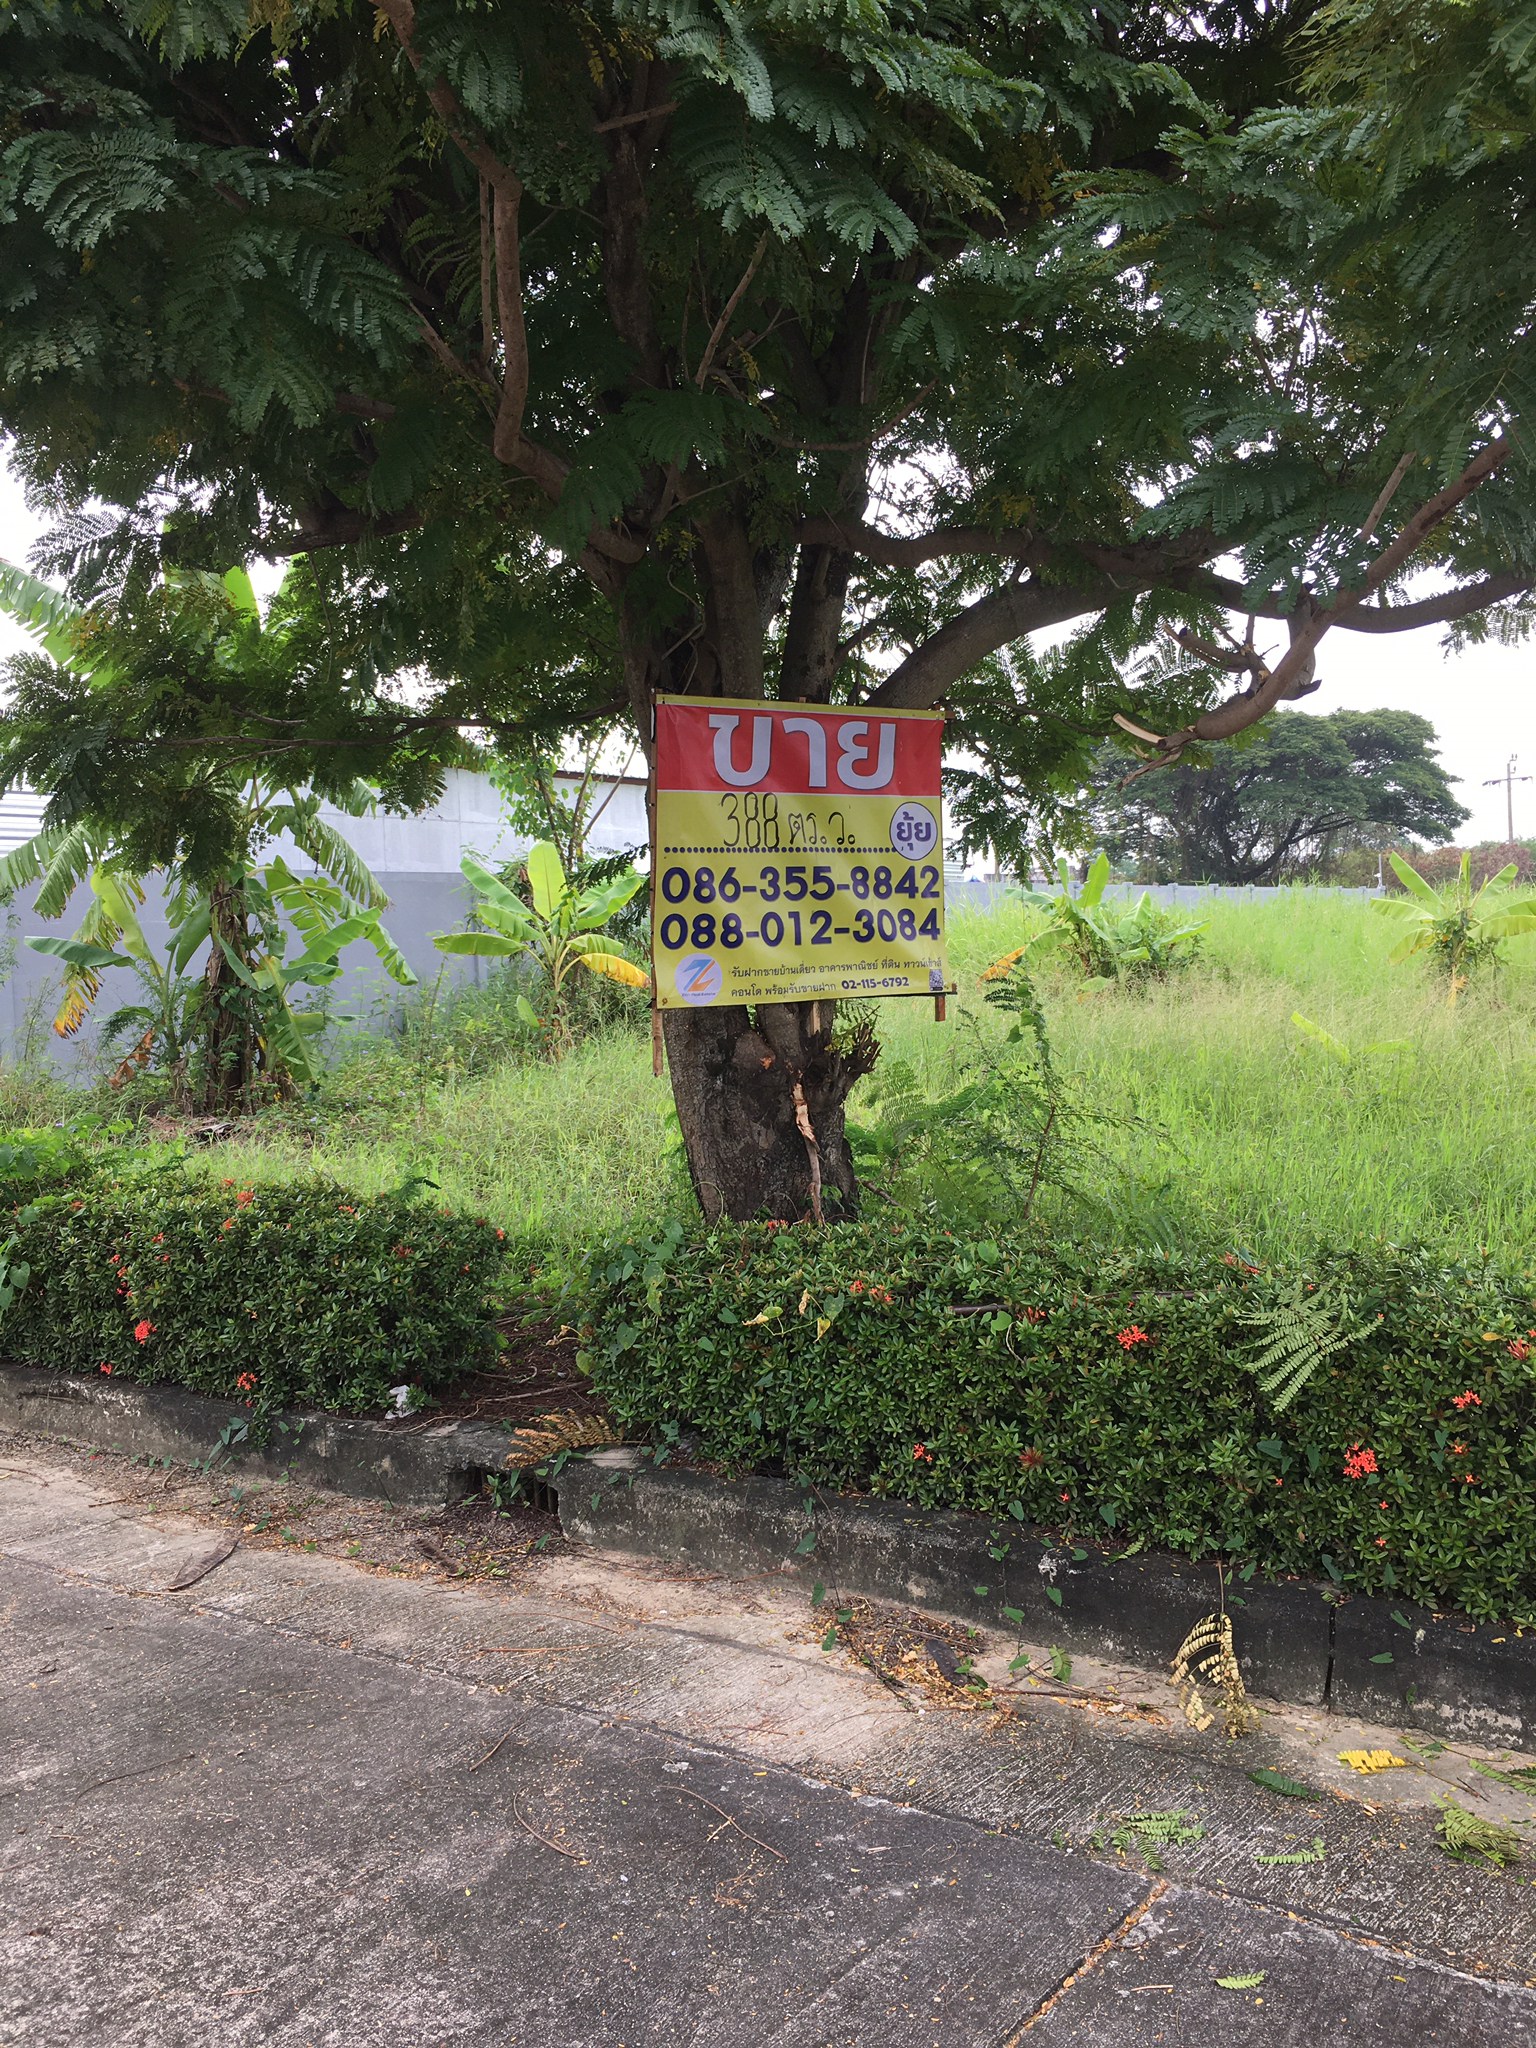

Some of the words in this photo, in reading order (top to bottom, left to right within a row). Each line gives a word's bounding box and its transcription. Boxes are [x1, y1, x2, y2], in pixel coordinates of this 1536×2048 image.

[708, 714, 896, 790] ขาย
[720, 792, 780, 849] 388
[896, 811, 932, 851] ยุ้ย
[662, 866, 940, 904] 086-355-8842
[661, 908, 940, 950] 088-012-3084
[841, 977, 910, 990] 02-115-6792
